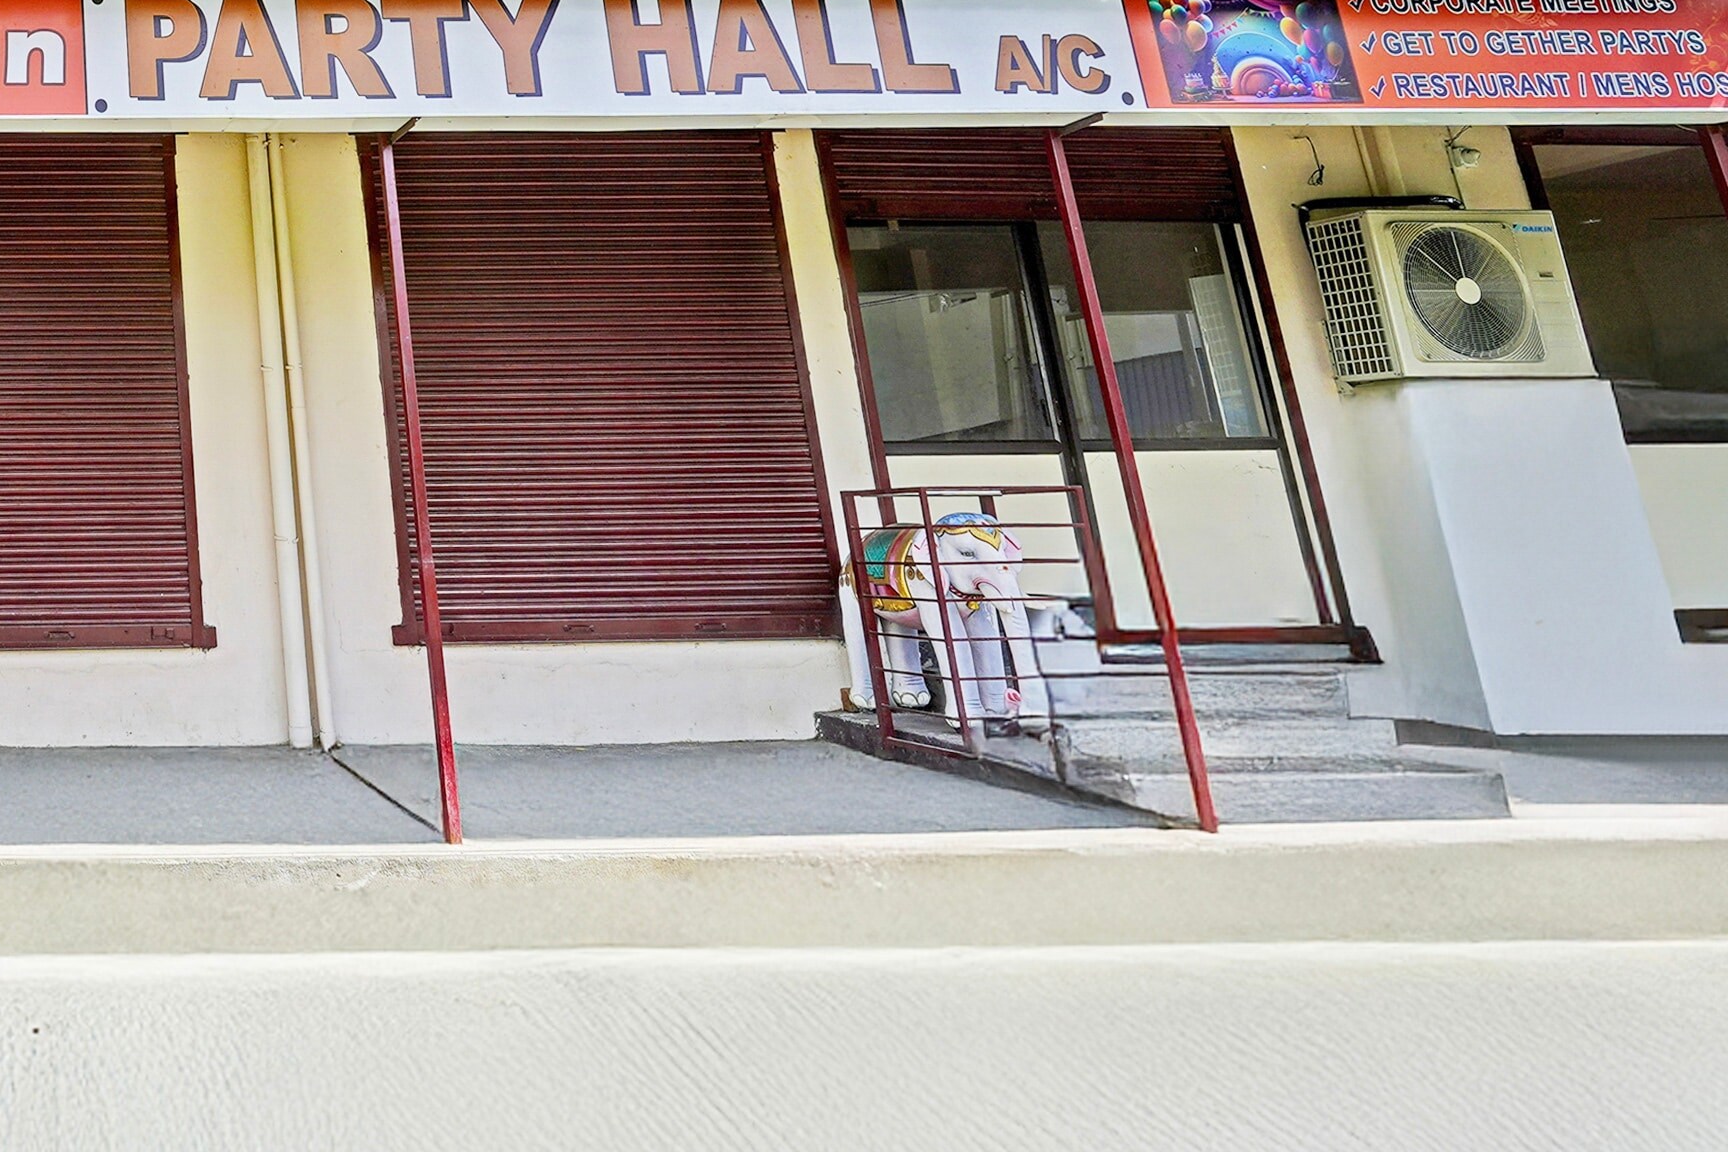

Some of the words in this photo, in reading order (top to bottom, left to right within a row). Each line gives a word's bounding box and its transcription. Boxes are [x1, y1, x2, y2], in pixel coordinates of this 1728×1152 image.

[1381, 30, 1436, 56] GET
[1440, 30, 1481, 55] TO
[1484, 29, 1598, 56] GETHER
[1601, 29, 1708, 56] PARTYS
[993, 33, 1110, 95] A/C
[1391, 72, 1571, 98] RESTAURANT
[1592, 72, 1672, 98] MENS
